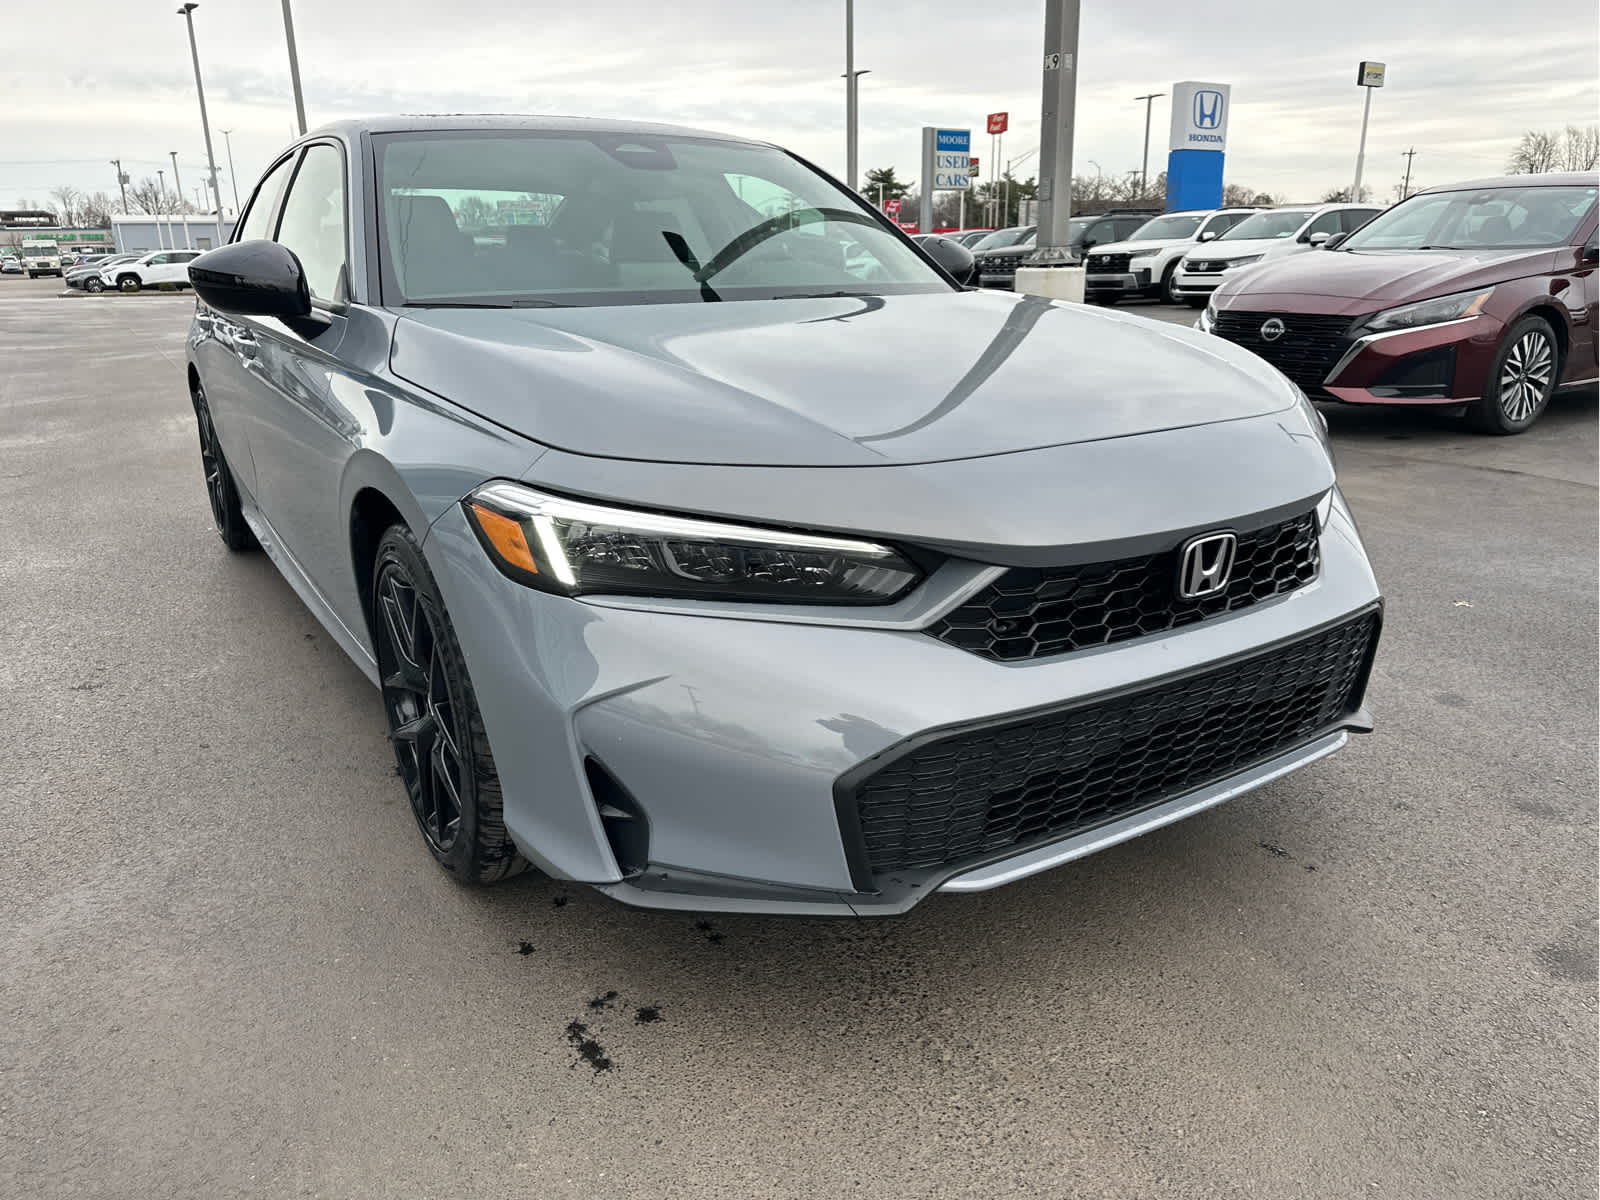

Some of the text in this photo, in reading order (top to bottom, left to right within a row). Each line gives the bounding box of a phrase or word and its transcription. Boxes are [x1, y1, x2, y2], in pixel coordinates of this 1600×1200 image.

[938, 135, 969, 145] MOORE
[1188, 133, 1223, 143] HONDA
[937, 155, 969, 169] USED
[936, 173, 969, 186] CARS
